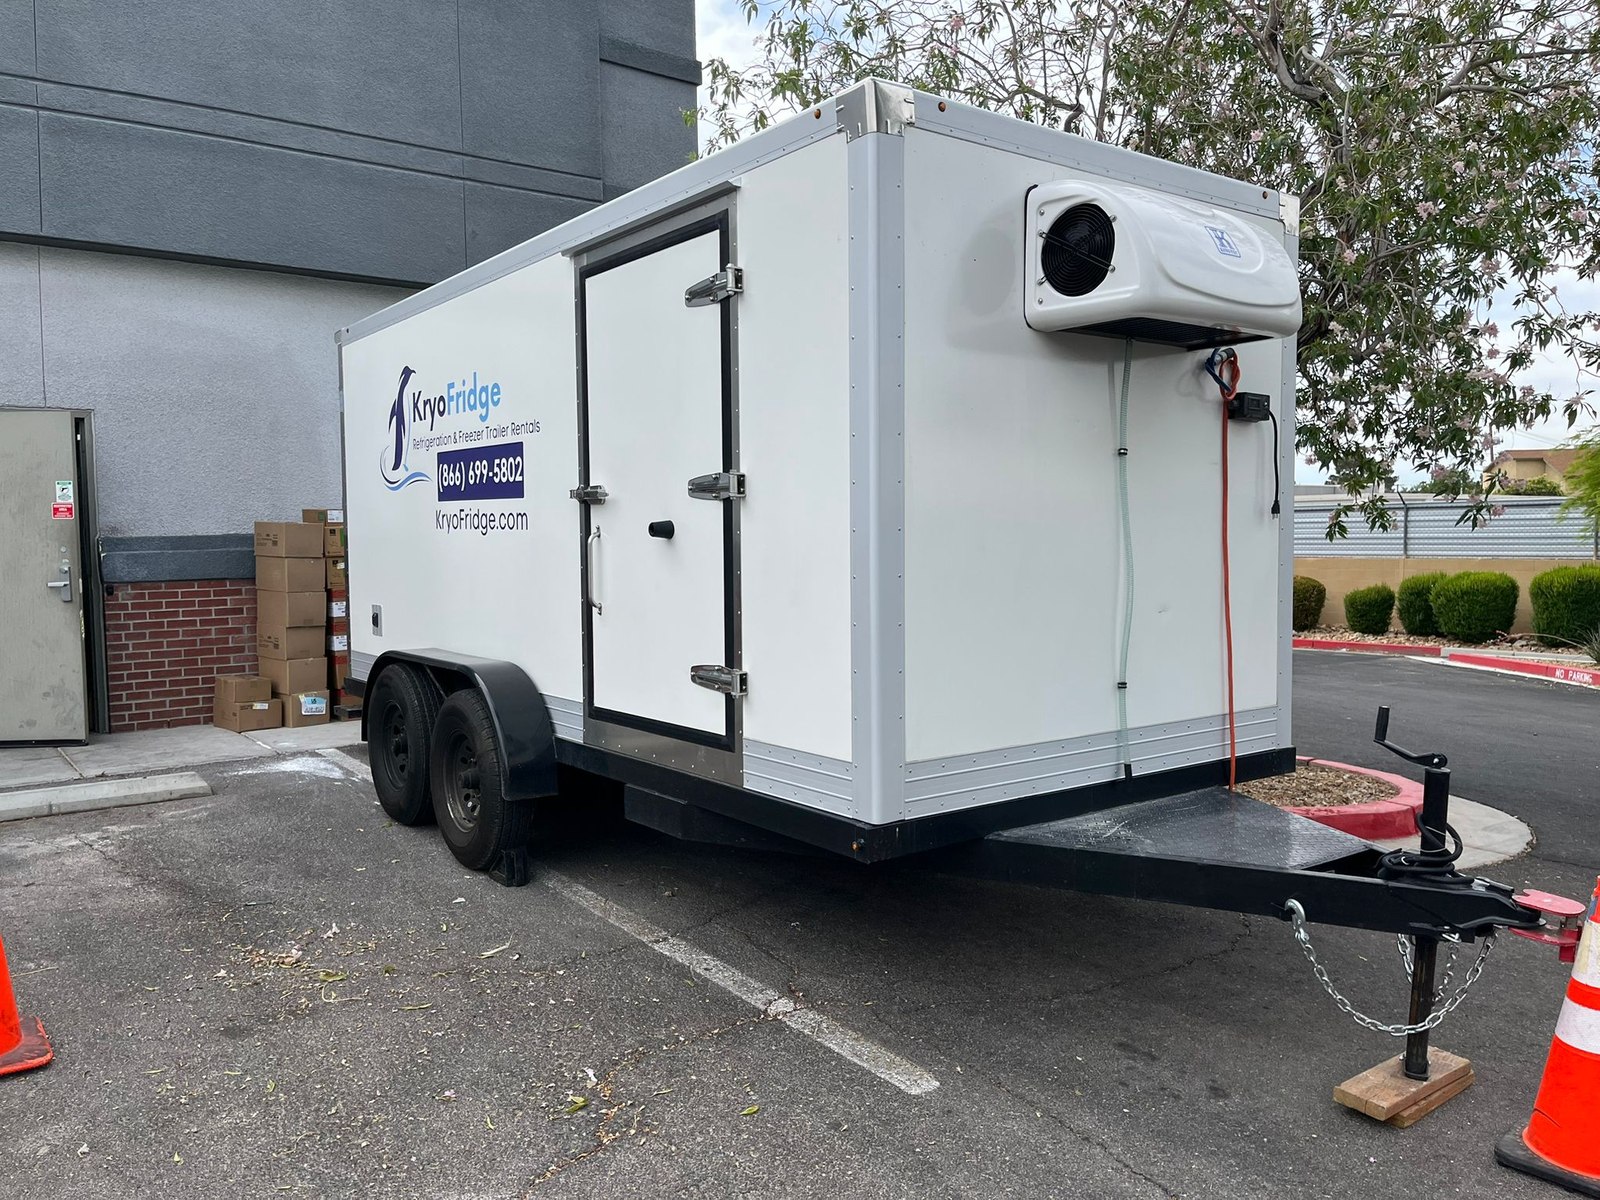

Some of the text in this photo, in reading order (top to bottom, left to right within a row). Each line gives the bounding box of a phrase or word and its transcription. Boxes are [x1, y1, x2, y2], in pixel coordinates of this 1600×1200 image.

[412, 371, 501, 432] KryoFridge
[412, 419, 541, 452] Refrigeration & Freezer Trailer Rentals
[438, 456, 523, 493] (866) 699-5802
[435, 508, 529, 536] KryoFridge.com
[1555, 668, 1593, 683] NO PARKING
